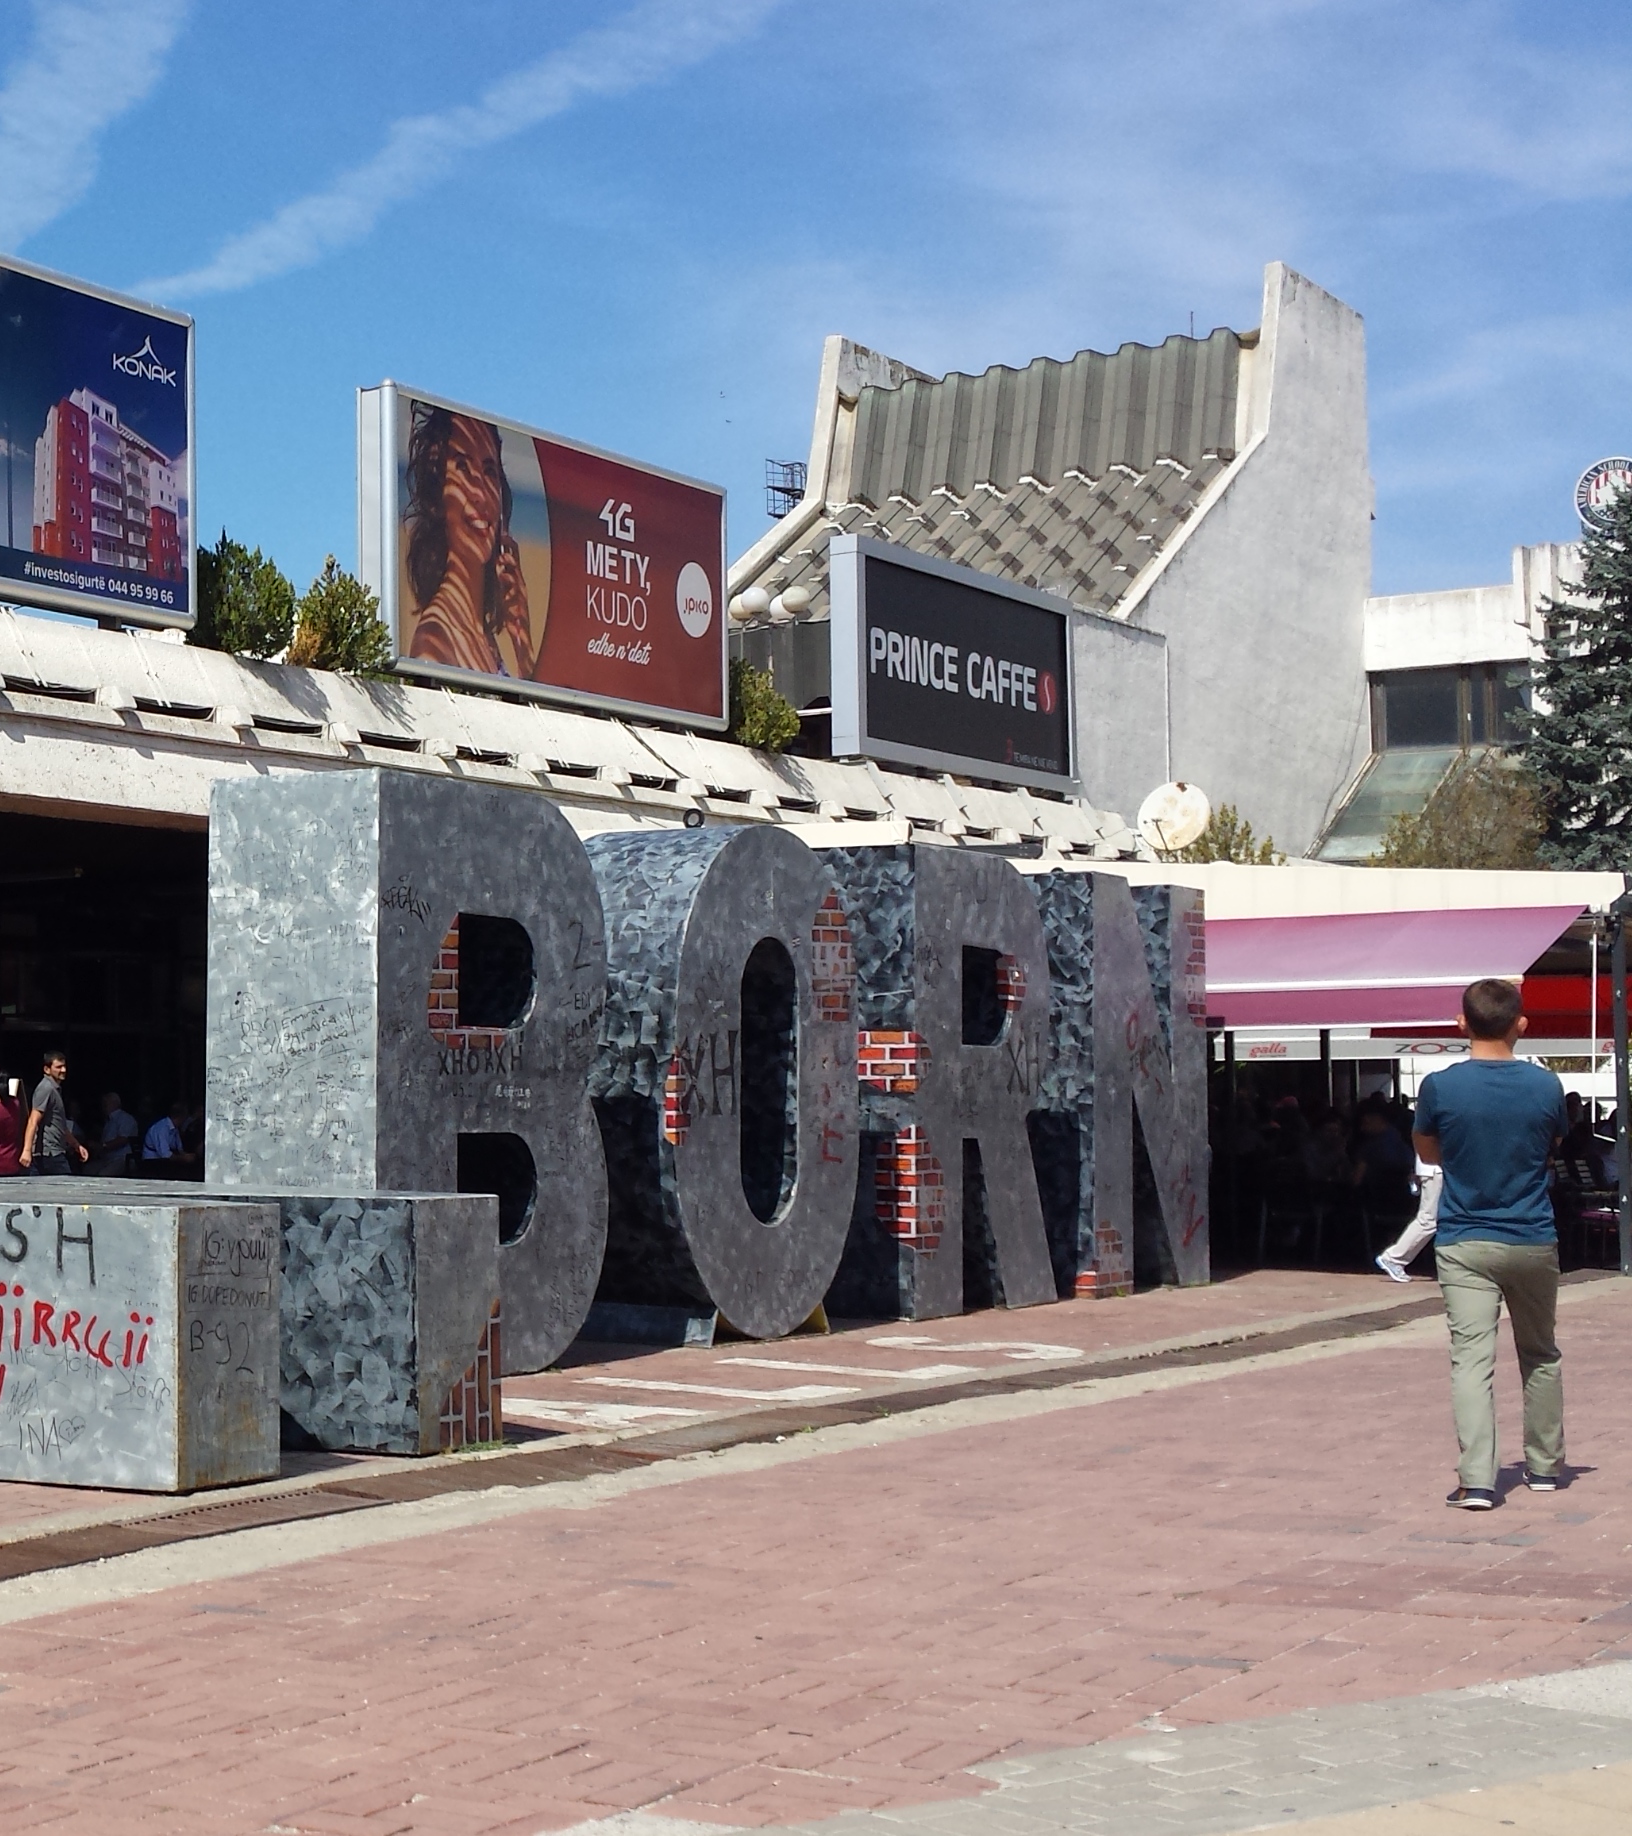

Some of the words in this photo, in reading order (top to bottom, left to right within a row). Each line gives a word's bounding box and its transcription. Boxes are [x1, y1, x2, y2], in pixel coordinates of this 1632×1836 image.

[113, 352, 177, 388] KONAK
[598, 498, 635, 543] 4G
[24, 561, 106, 591] #investosigurtë
[108, 581, 128, 595] 044
[130, 584, 144, 598] 95
[145, 586, 159, 601] 99
[160, 589, 174, 604] 66
[586, 540, 651, 595] METY,
[586, 585, 648, 632] KUDO
[587, 632, 616, 661] edhe
[870, 626, 959, 694] PRINCE
[966, 651, 1037, 713] CAFFE
